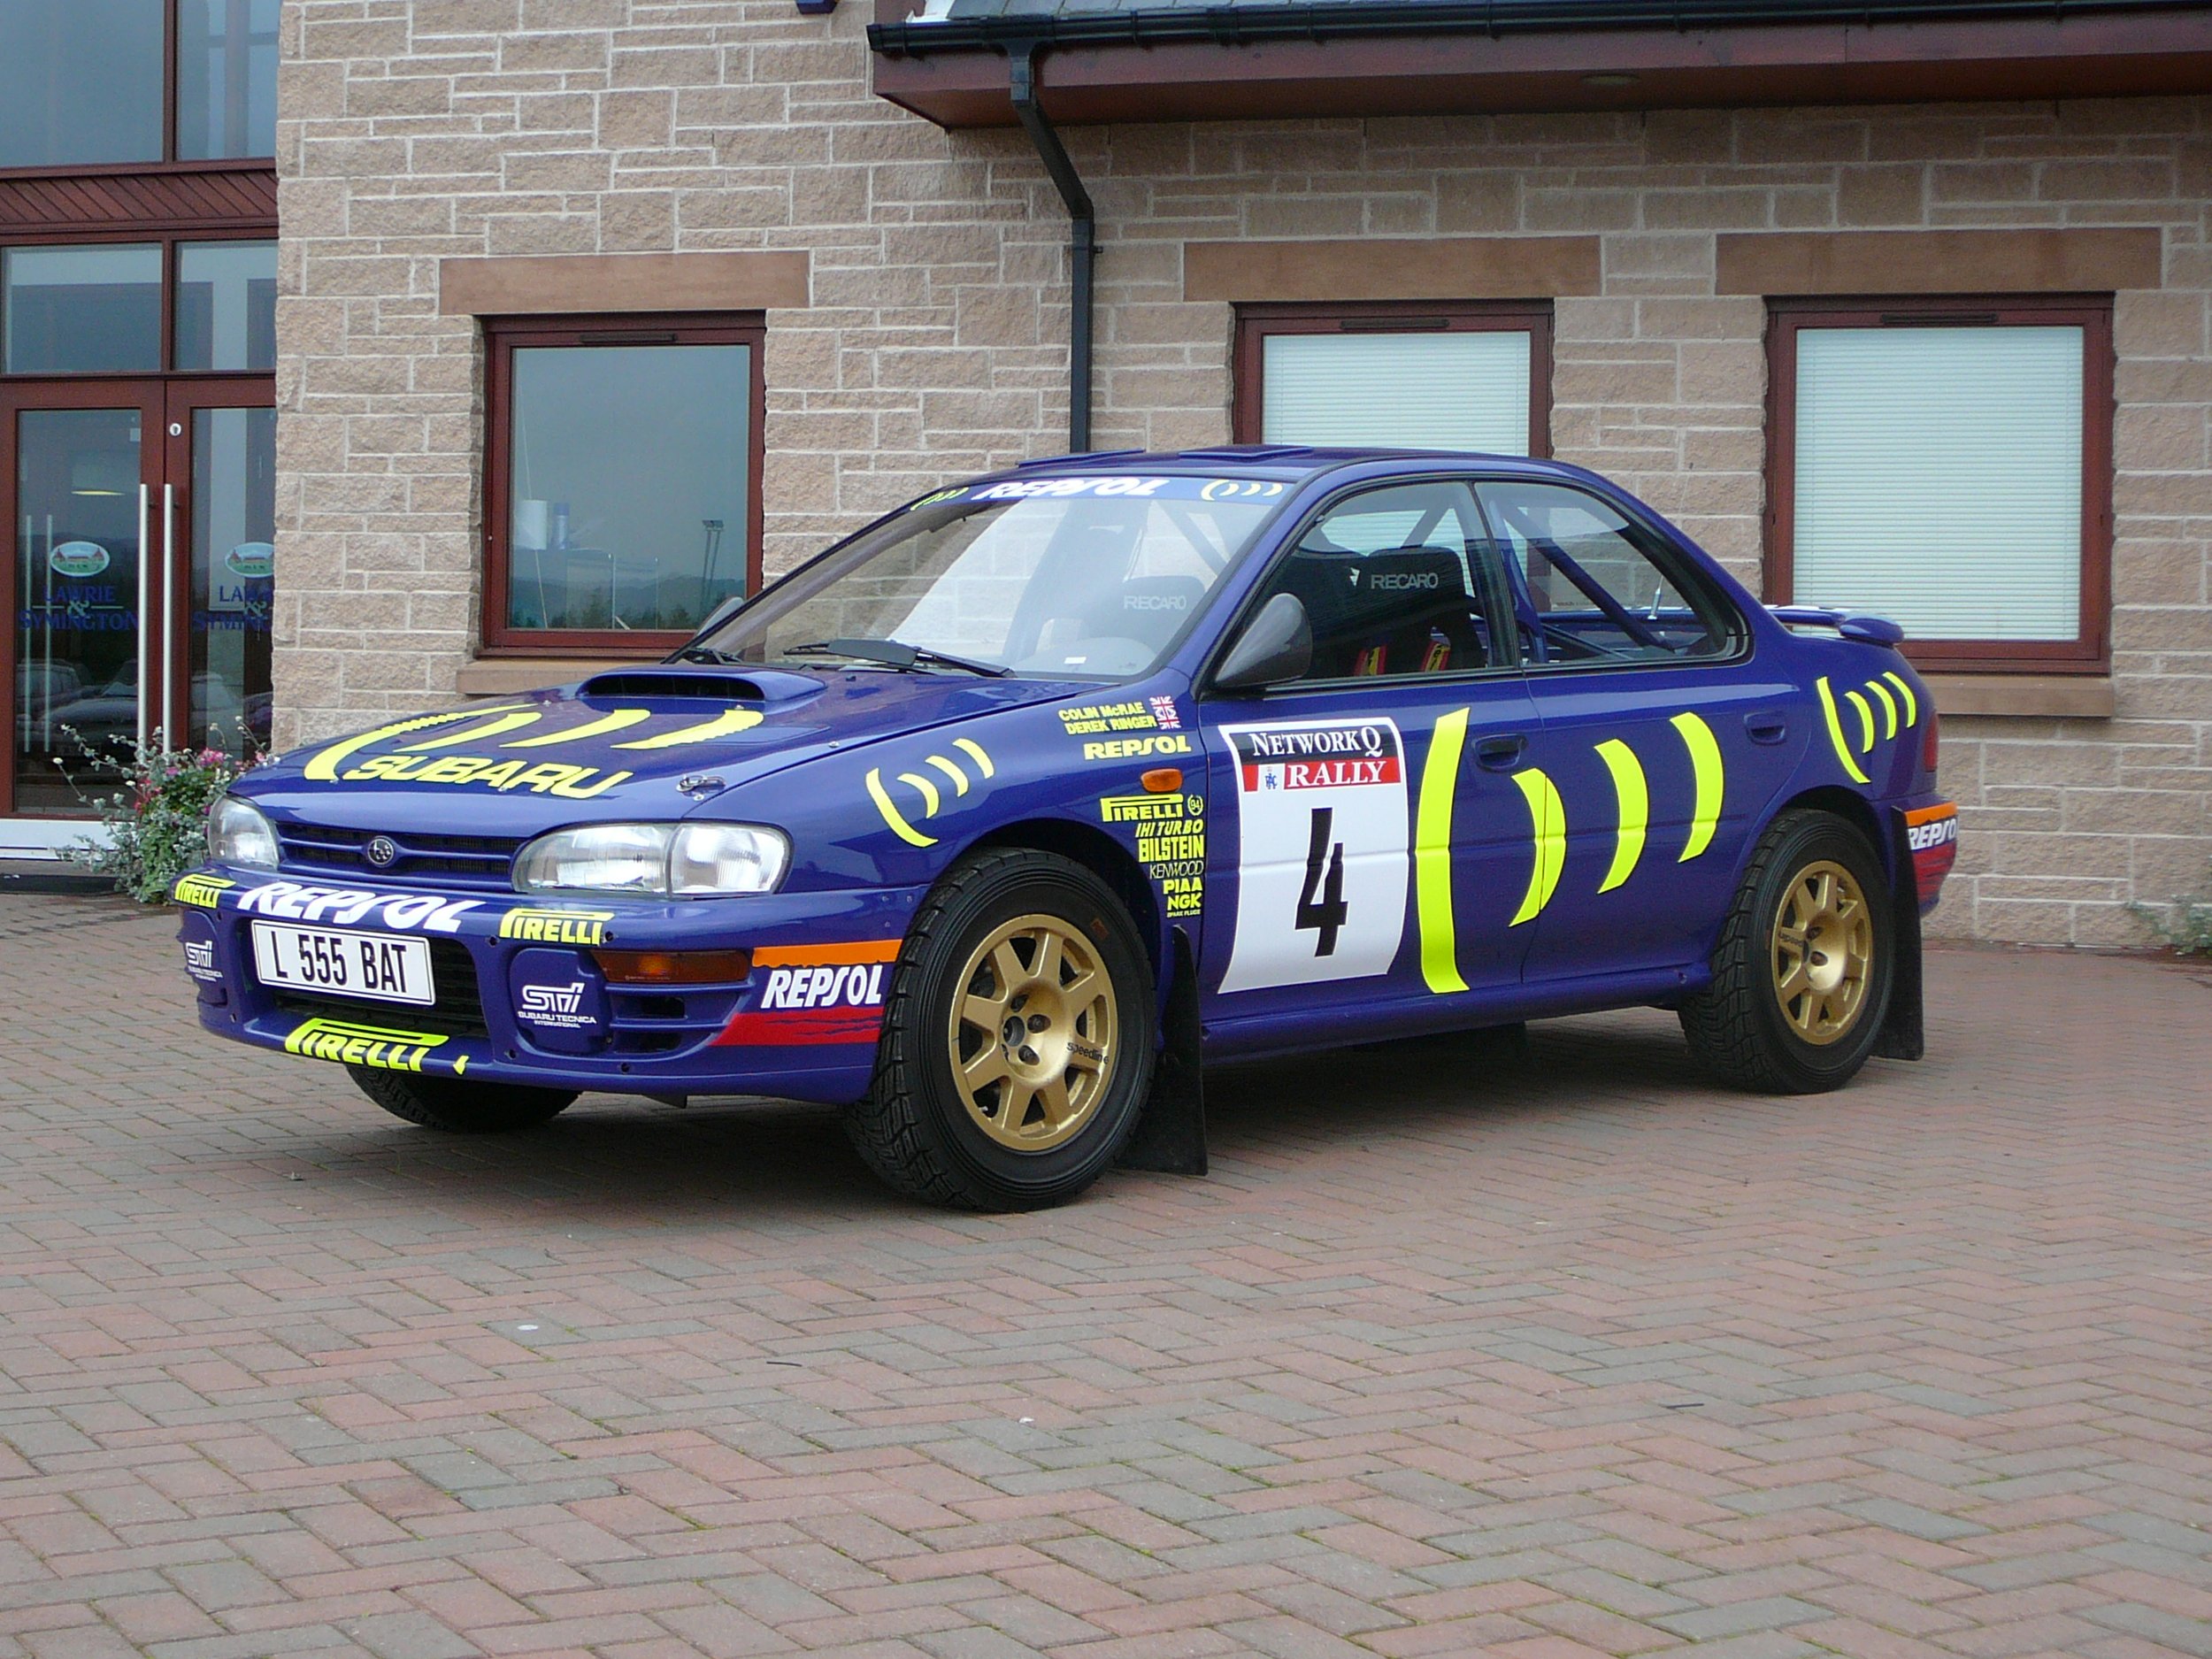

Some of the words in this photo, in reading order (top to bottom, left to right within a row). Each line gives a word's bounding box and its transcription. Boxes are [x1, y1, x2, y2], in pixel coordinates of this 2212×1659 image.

[971, 477, 1169, 500] REPSOL
[1371, 572, 1438, 589] RECARO
[44, 586, 116, 603] LAWRIE
[1124, 595, 1187, 611] RECARO
[193, 611, 273, 632] SYMING
[1057, 706, 1099, 722] COLIN
[1064, 718, 1110, 735] DEREK
[1110, 715, 1158, 731] RINGER
[1083, 735, 1192, 760] REPSOL
[1249, 729, 1361, 757] NETWORK
[1362, 726, 1383, 757] Q
[342, 756, 634, 799] SUBARU
[1287, 761, 1386, 787] RALLY
[1100, 794, 1184, 822] PIRELLI
[1135, 822, 1156, 838] IHI
[1156, 819, 1204, 836] TURBO
[1908, 818, 1958, 850] REPSO
[1138, 834, 1204, 863] BILSTEIN
[1149, 861, 1204, 879] KENWOOD
[1294, 807, 1349, 957] 4
[174, 873, 236, 909] PIRELLI
[1163, 877, 1203, 895] PIAA
[237, 881, 487, 933] REPSOL
[1167, 893, 1202, 911] NGK
[499, 908, 616, 947] PIRELLI
[271, 931, 288, 979] L
[297, 933, 349, 987] 555
[360, 941, 407, 993] BAT
[760, 964, 883, 1009] REPSOL
[517, 1010, 555, 1021] SUBARU
[556, 1014, 597, 1025] TECNICA
[285, 1018, 449, 1071] PIRELLI
